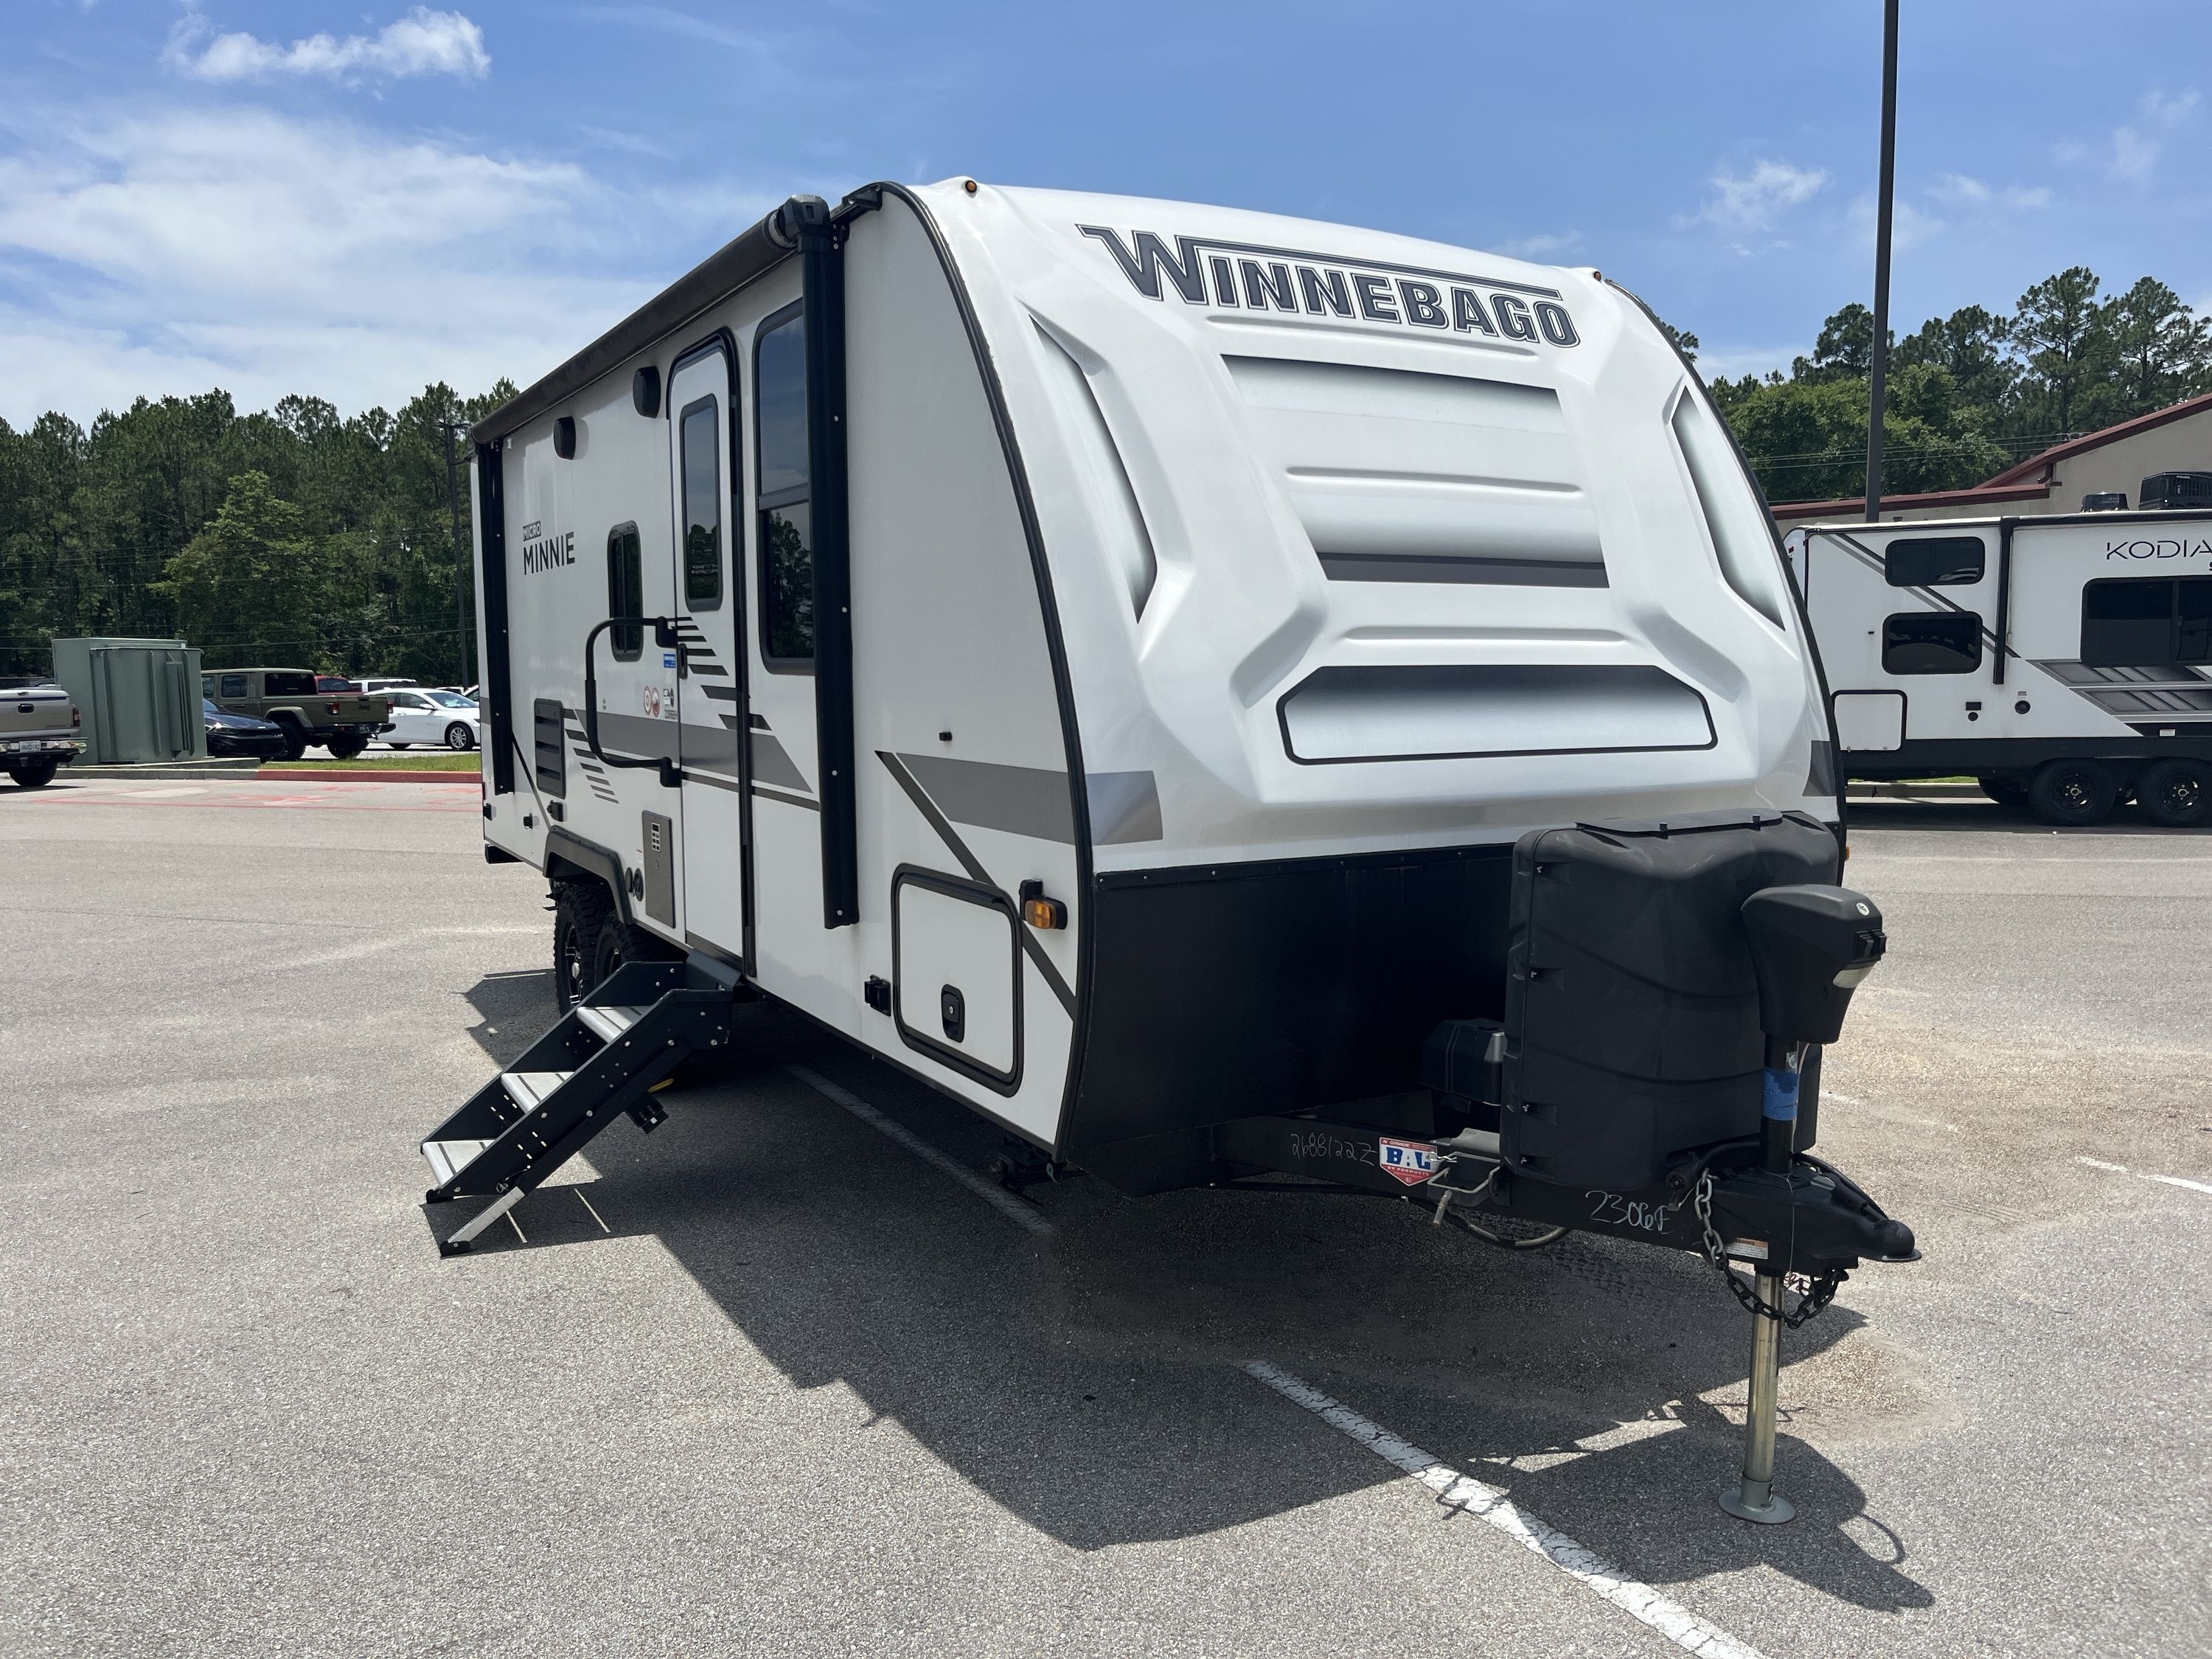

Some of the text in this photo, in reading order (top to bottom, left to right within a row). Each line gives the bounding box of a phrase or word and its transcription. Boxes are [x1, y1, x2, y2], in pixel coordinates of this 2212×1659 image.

[1075, 223, 1581, 348] WINNEBAGO
[523, 522, 541, 540] MICRO
[524, 532, 575, 575] MINNIE
[1386, 1147, 1430, 1170] BAL
[1397, 1168, 1429, 1176] PRODUCTS
